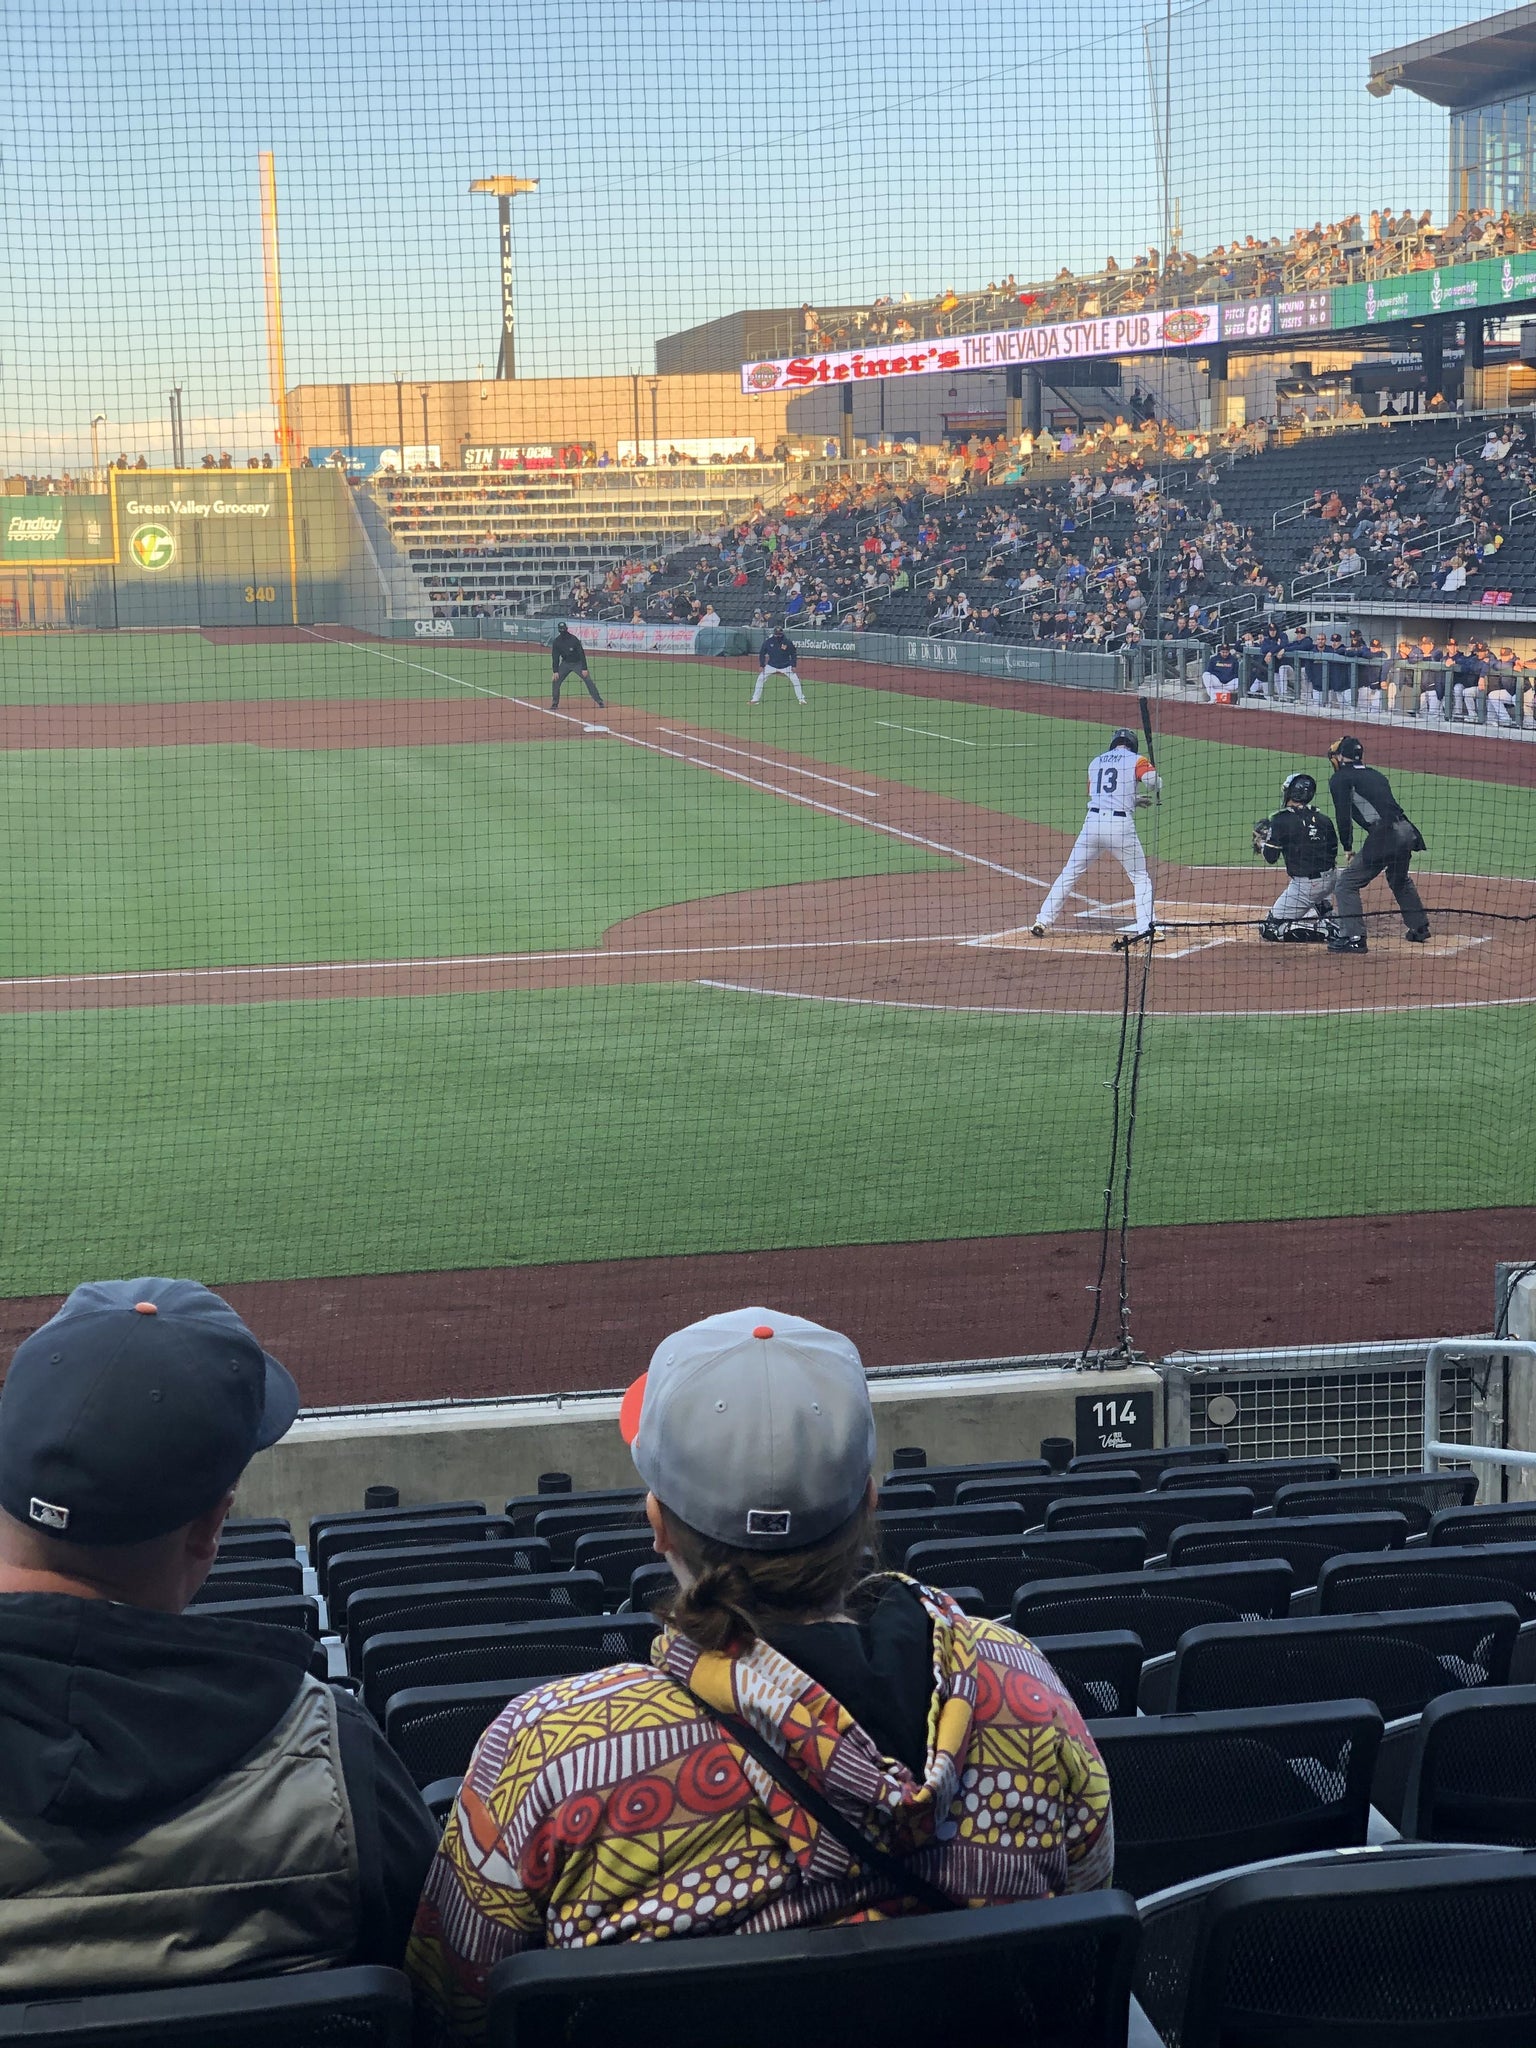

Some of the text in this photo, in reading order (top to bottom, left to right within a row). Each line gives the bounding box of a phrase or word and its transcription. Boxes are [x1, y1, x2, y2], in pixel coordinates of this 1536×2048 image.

[502, 224, 514, 333] FINDLAY
[1278, 300, 1305, 313] MOUND
[1320, 295, 1326, 307] 0
[1224, 308, 1245, 321] PITCH
[1280, 316, 1303, 329] VISITS
[1320, 312, 1326, 323] 0
[1224, 323, 1245, 336] SPEED
[782, 317, 1150, 387] Steiner's THE NEVADA STYLE PUB
[464, 446, 554, 464] STN THE LOCAL
[126, 500, 270, 517] Green Valley Grocery
[8, 516, 62, 531] Findlay
[7, 533, 56, 541] TOYOTA
[244, 586, 275, 602] 340
[1096, 767, 1118, 794] 13
[1092, 1400, 1137, 1427] 114
